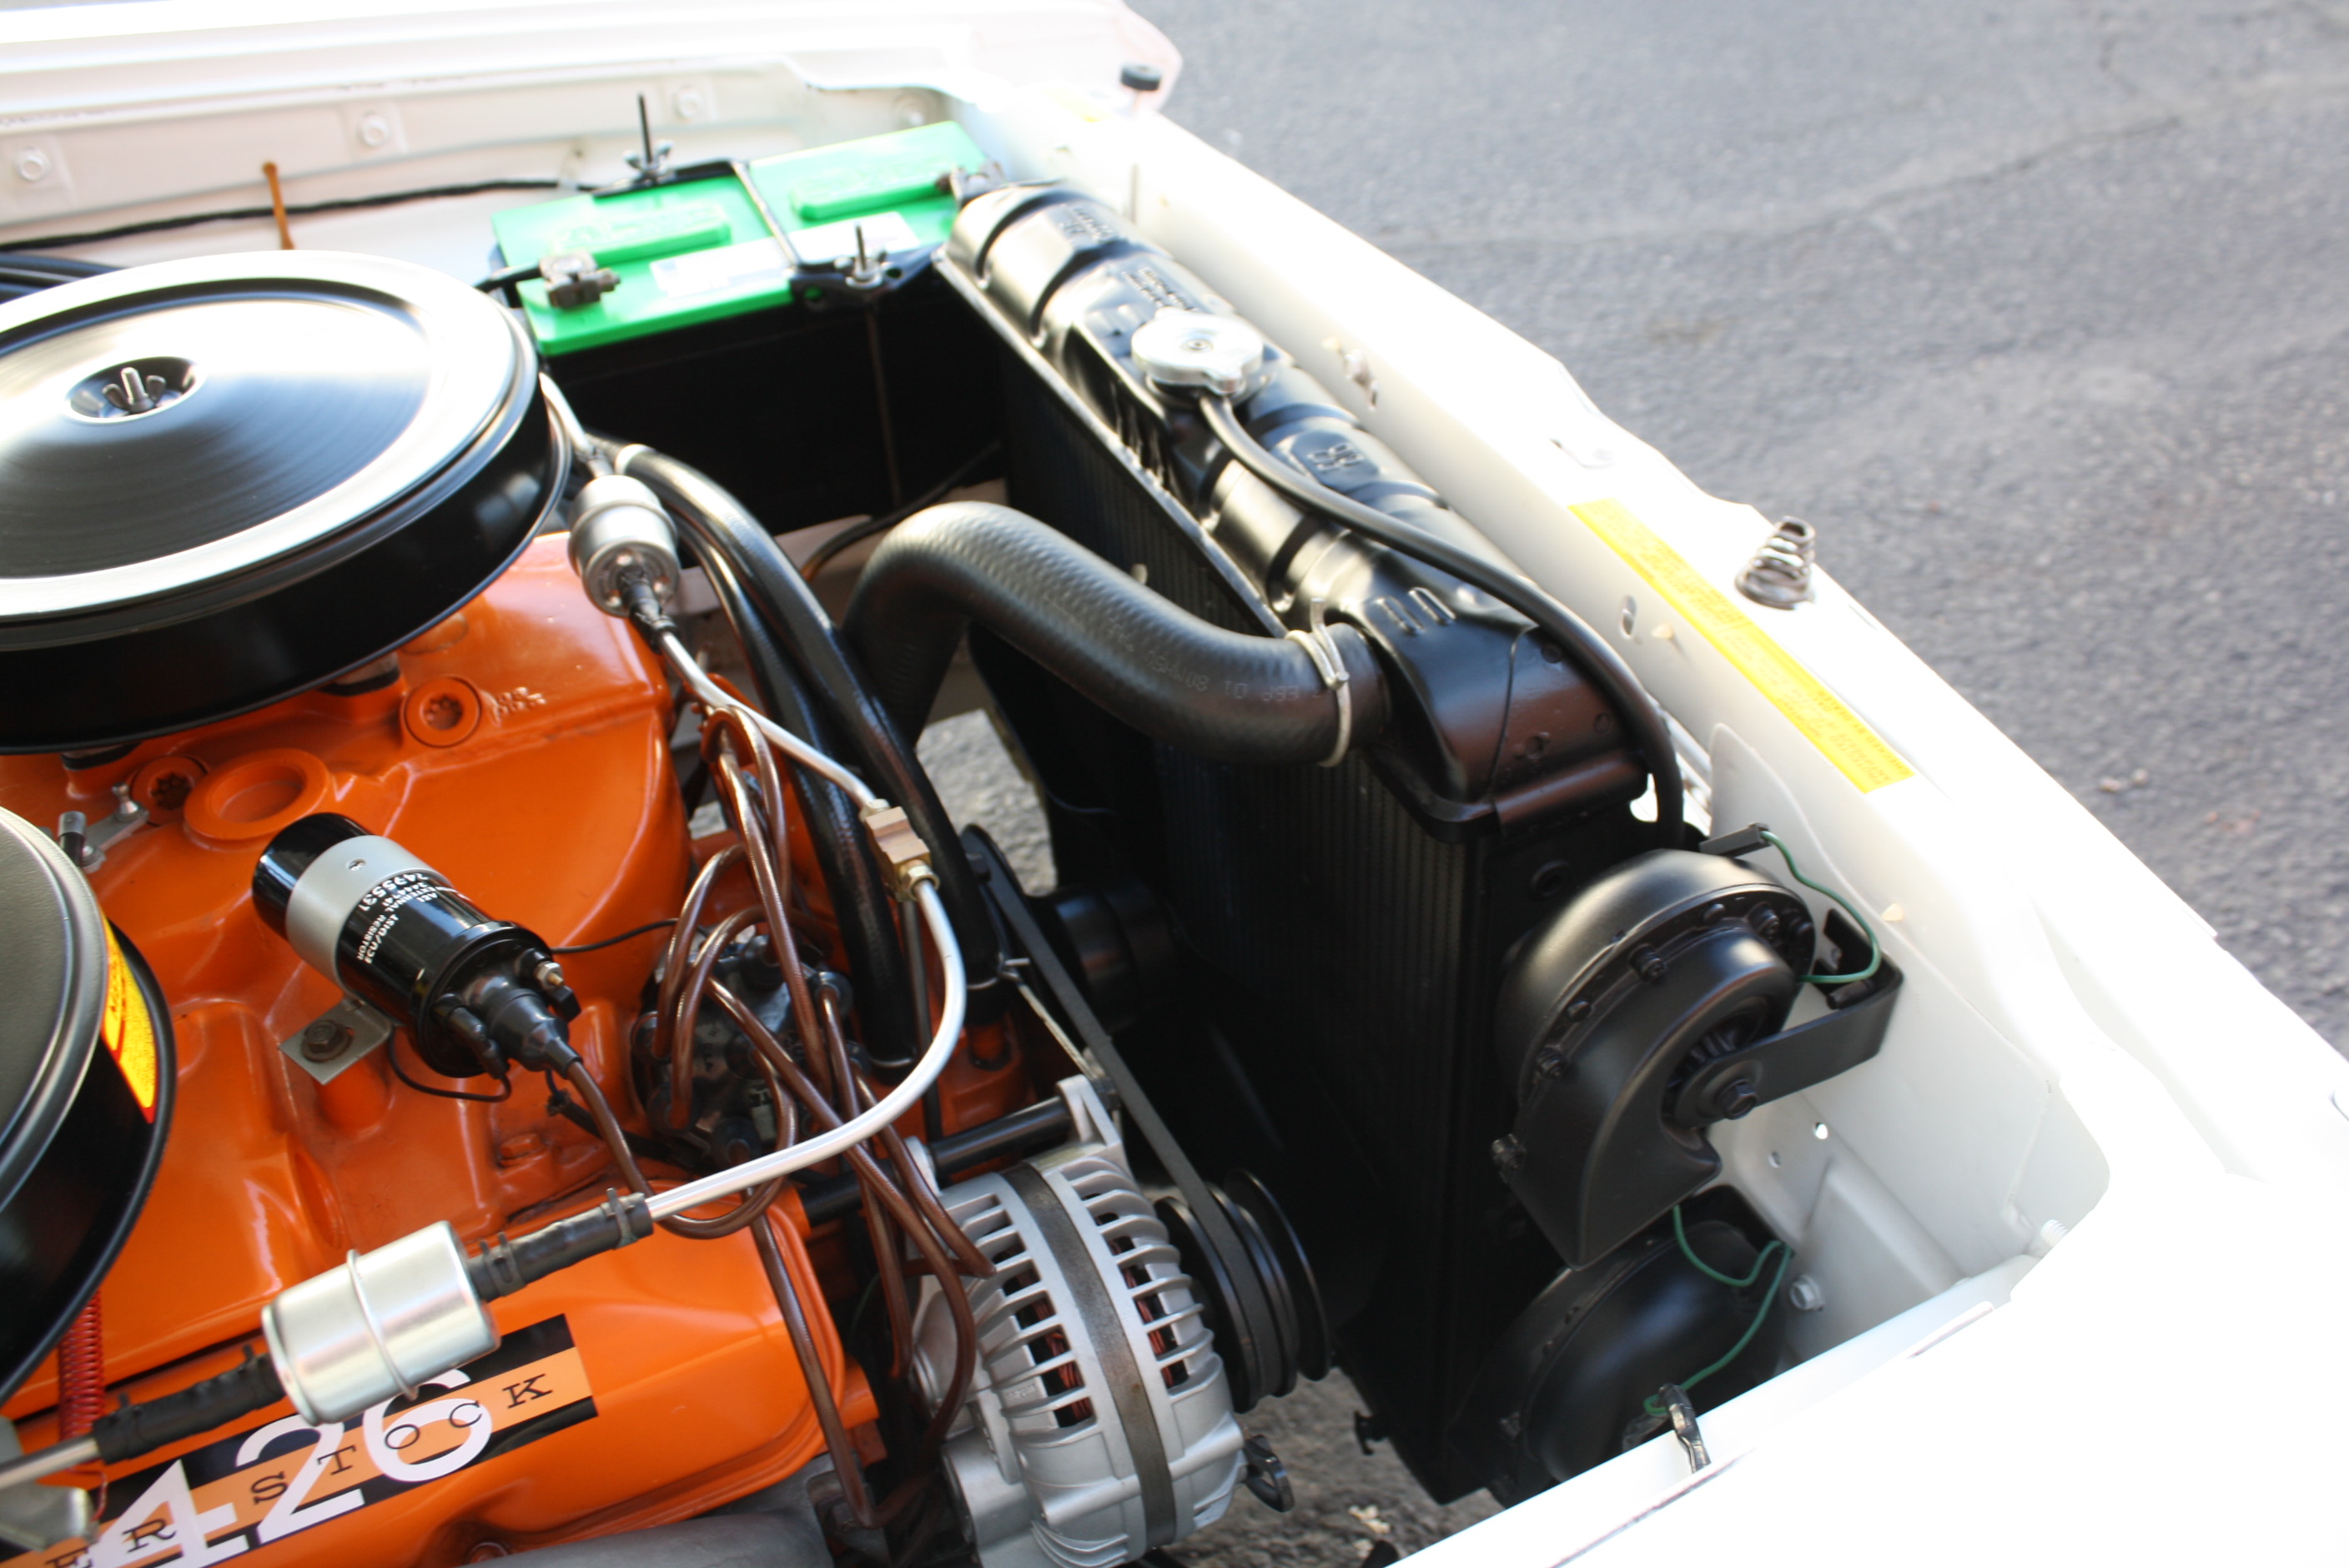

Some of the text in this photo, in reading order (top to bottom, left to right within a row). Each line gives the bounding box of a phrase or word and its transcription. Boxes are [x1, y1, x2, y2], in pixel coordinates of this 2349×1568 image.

[1814, 690, 1853, 721] DEALER
[1850, 722, 1867, 734] BY
[1864, 736, 1912, 776] CHECKED
[357, 887, 436, 960] EXTERNAL RESISTOR
[250, 1374, 552, 1505] STOCK
[78, 1368, 492, 1568] 426
